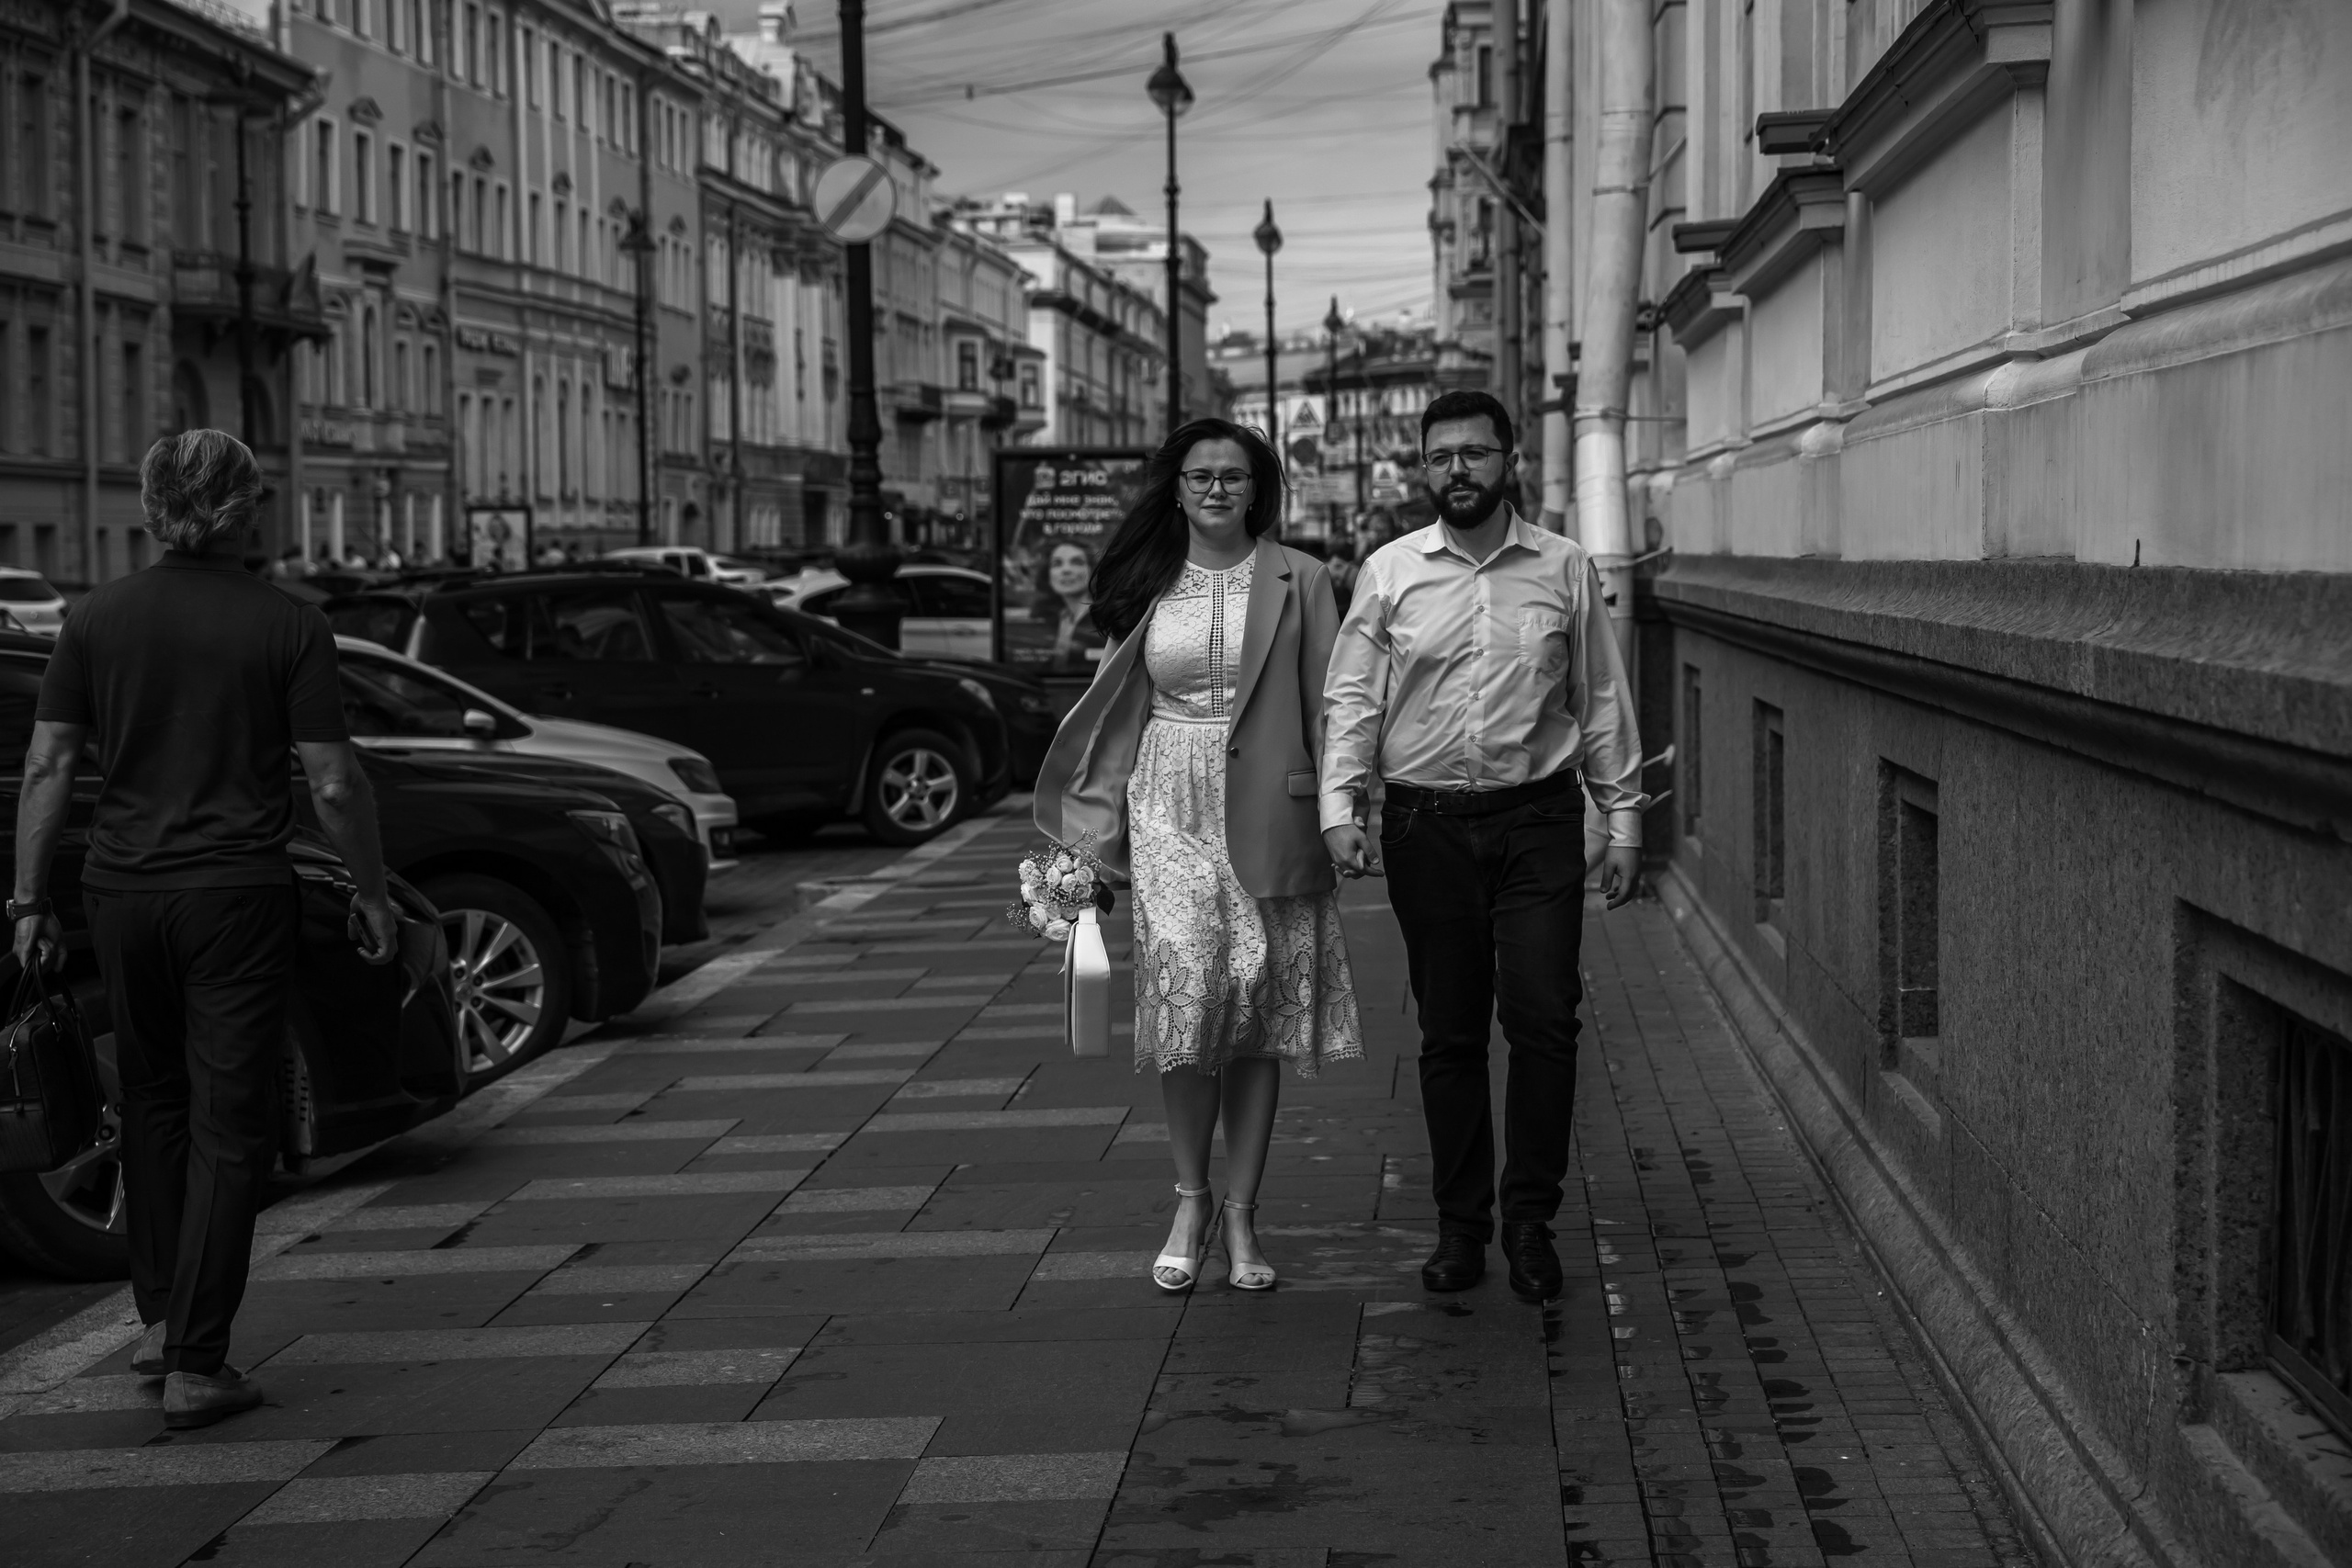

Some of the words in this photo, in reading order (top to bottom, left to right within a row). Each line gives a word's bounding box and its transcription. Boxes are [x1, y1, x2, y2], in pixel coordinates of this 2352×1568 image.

[1059, 470, 1107, 486] 2ГИС
[1054, 494, 1080, 506] мне
[1055, 522, 1102, 536] городе
